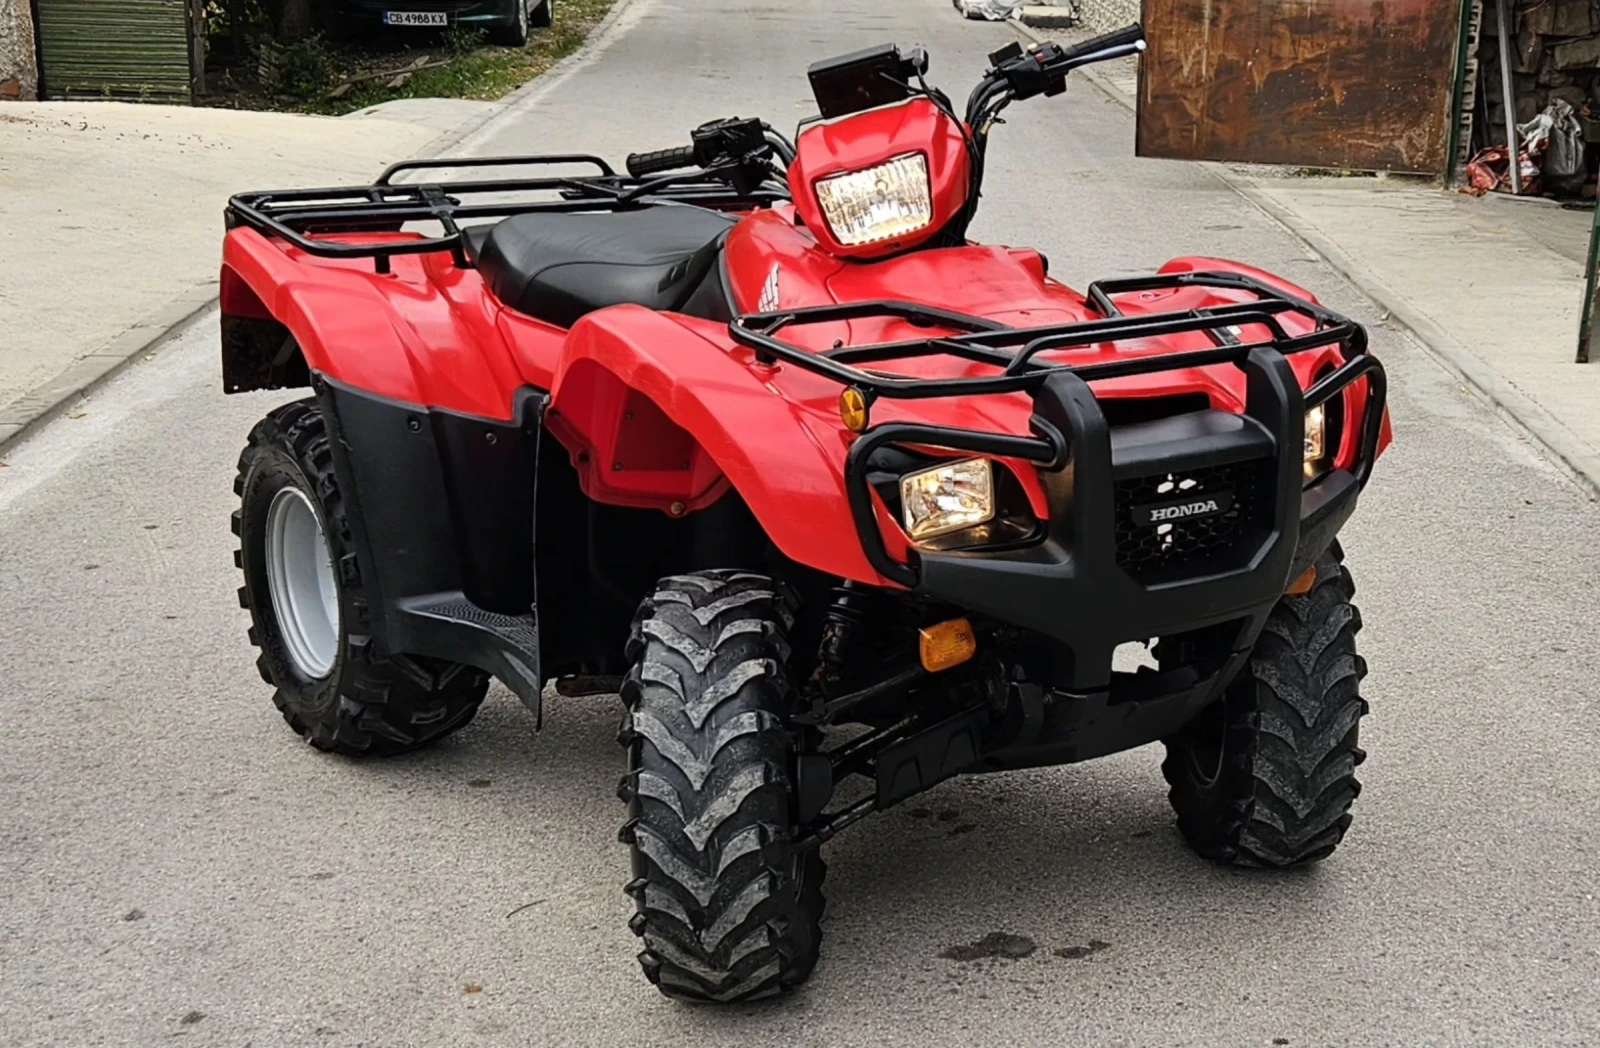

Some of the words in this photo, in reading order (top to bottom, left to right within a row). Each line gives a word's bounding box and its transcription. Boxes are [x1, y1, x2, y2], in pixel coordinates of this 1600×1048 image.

[389, 13, 403, 24] CB
[431, 14, 445, 24] KX
[1150, 501, 1218, 521] HONDA
